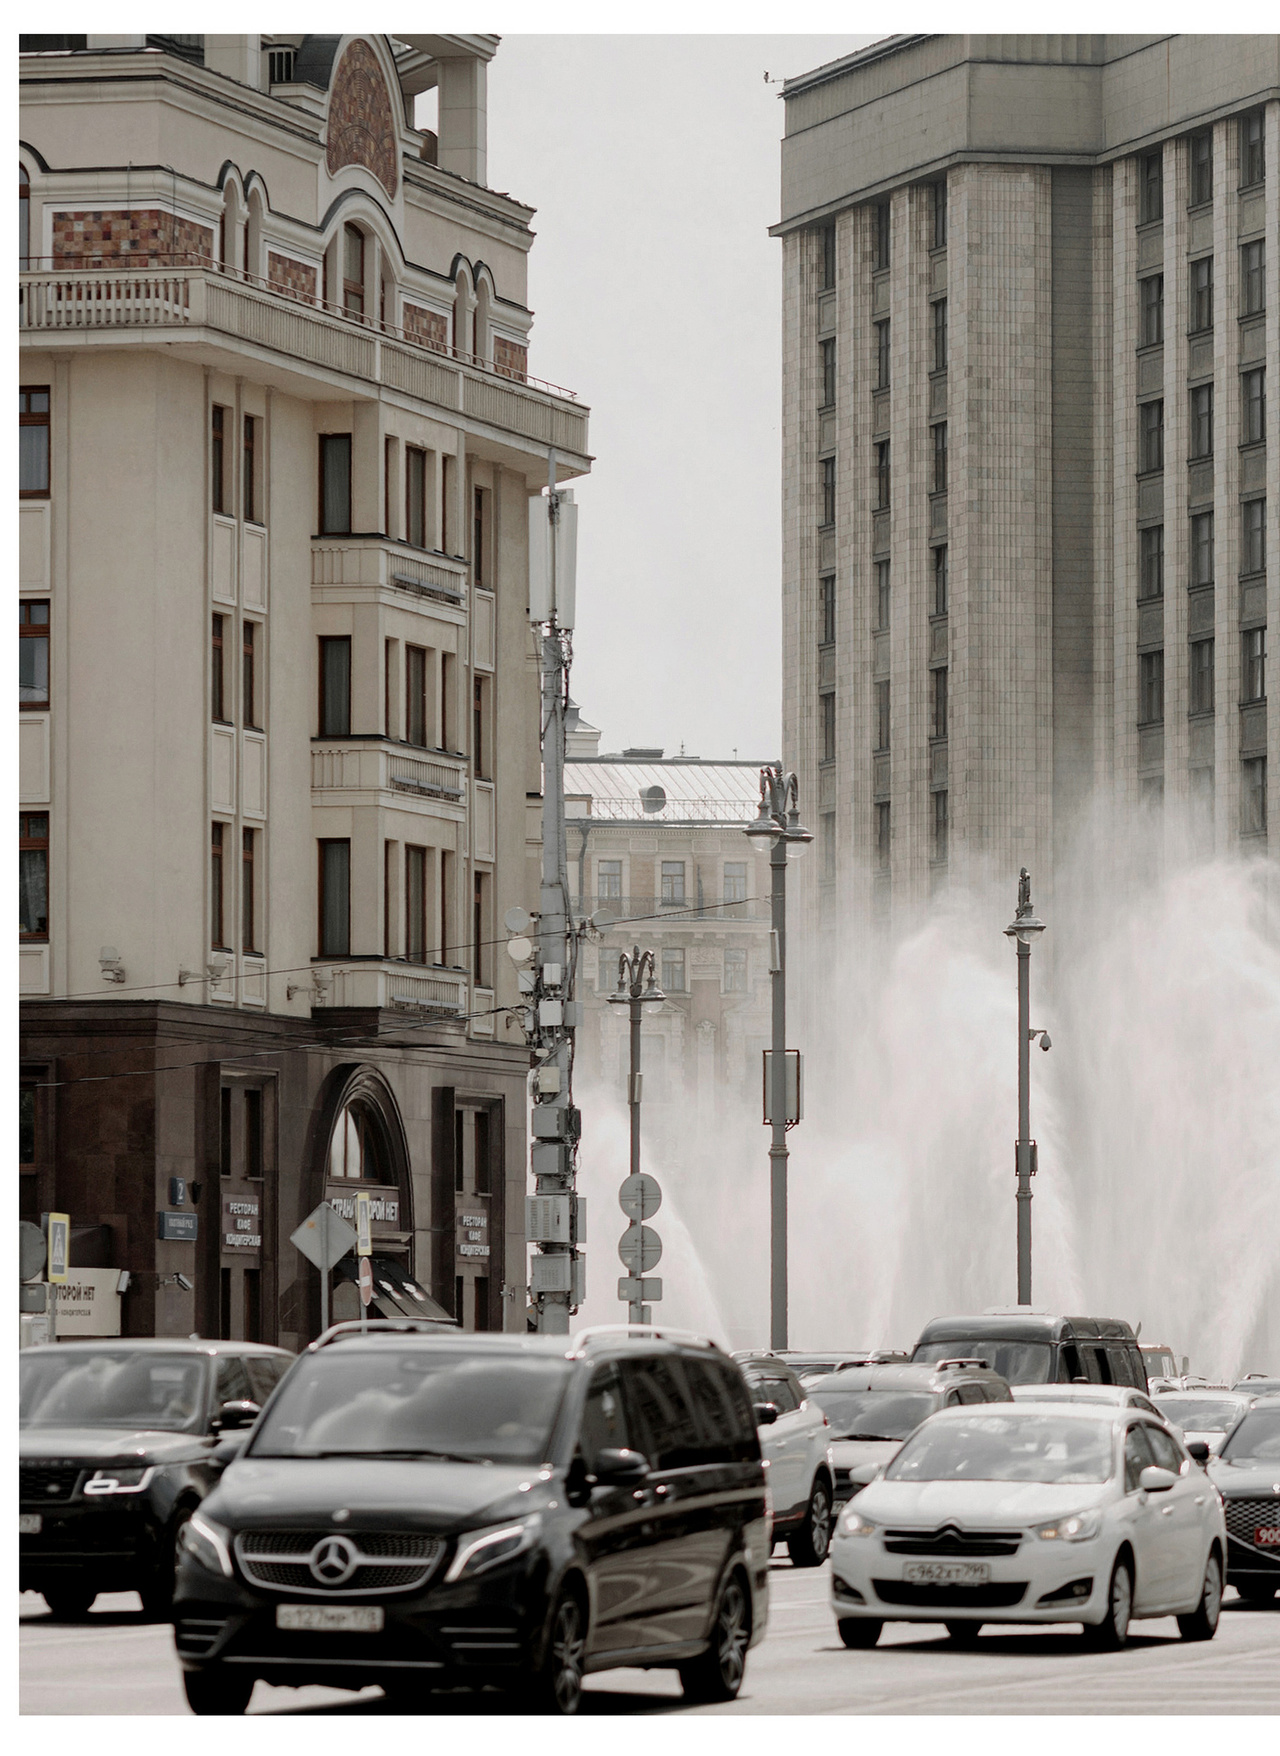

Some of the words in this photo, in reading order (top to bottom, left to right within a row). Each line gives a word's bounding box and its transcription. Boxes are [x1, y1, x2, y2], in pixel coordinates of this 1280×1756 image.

[177, 1182, 184, 1200] 2
[230, 1202, 259, 1215] РЕСТОРАН
[386, 1201, 399, 1221] НЕТ
[236, 1218, 251, 1230] КАФЕ
[463, 1215, 487, 1227] РЕСТОРАН
[468, 1230, 482, 1241] КАФЕ
[83, 1286, 95, 1301] НЕТ
